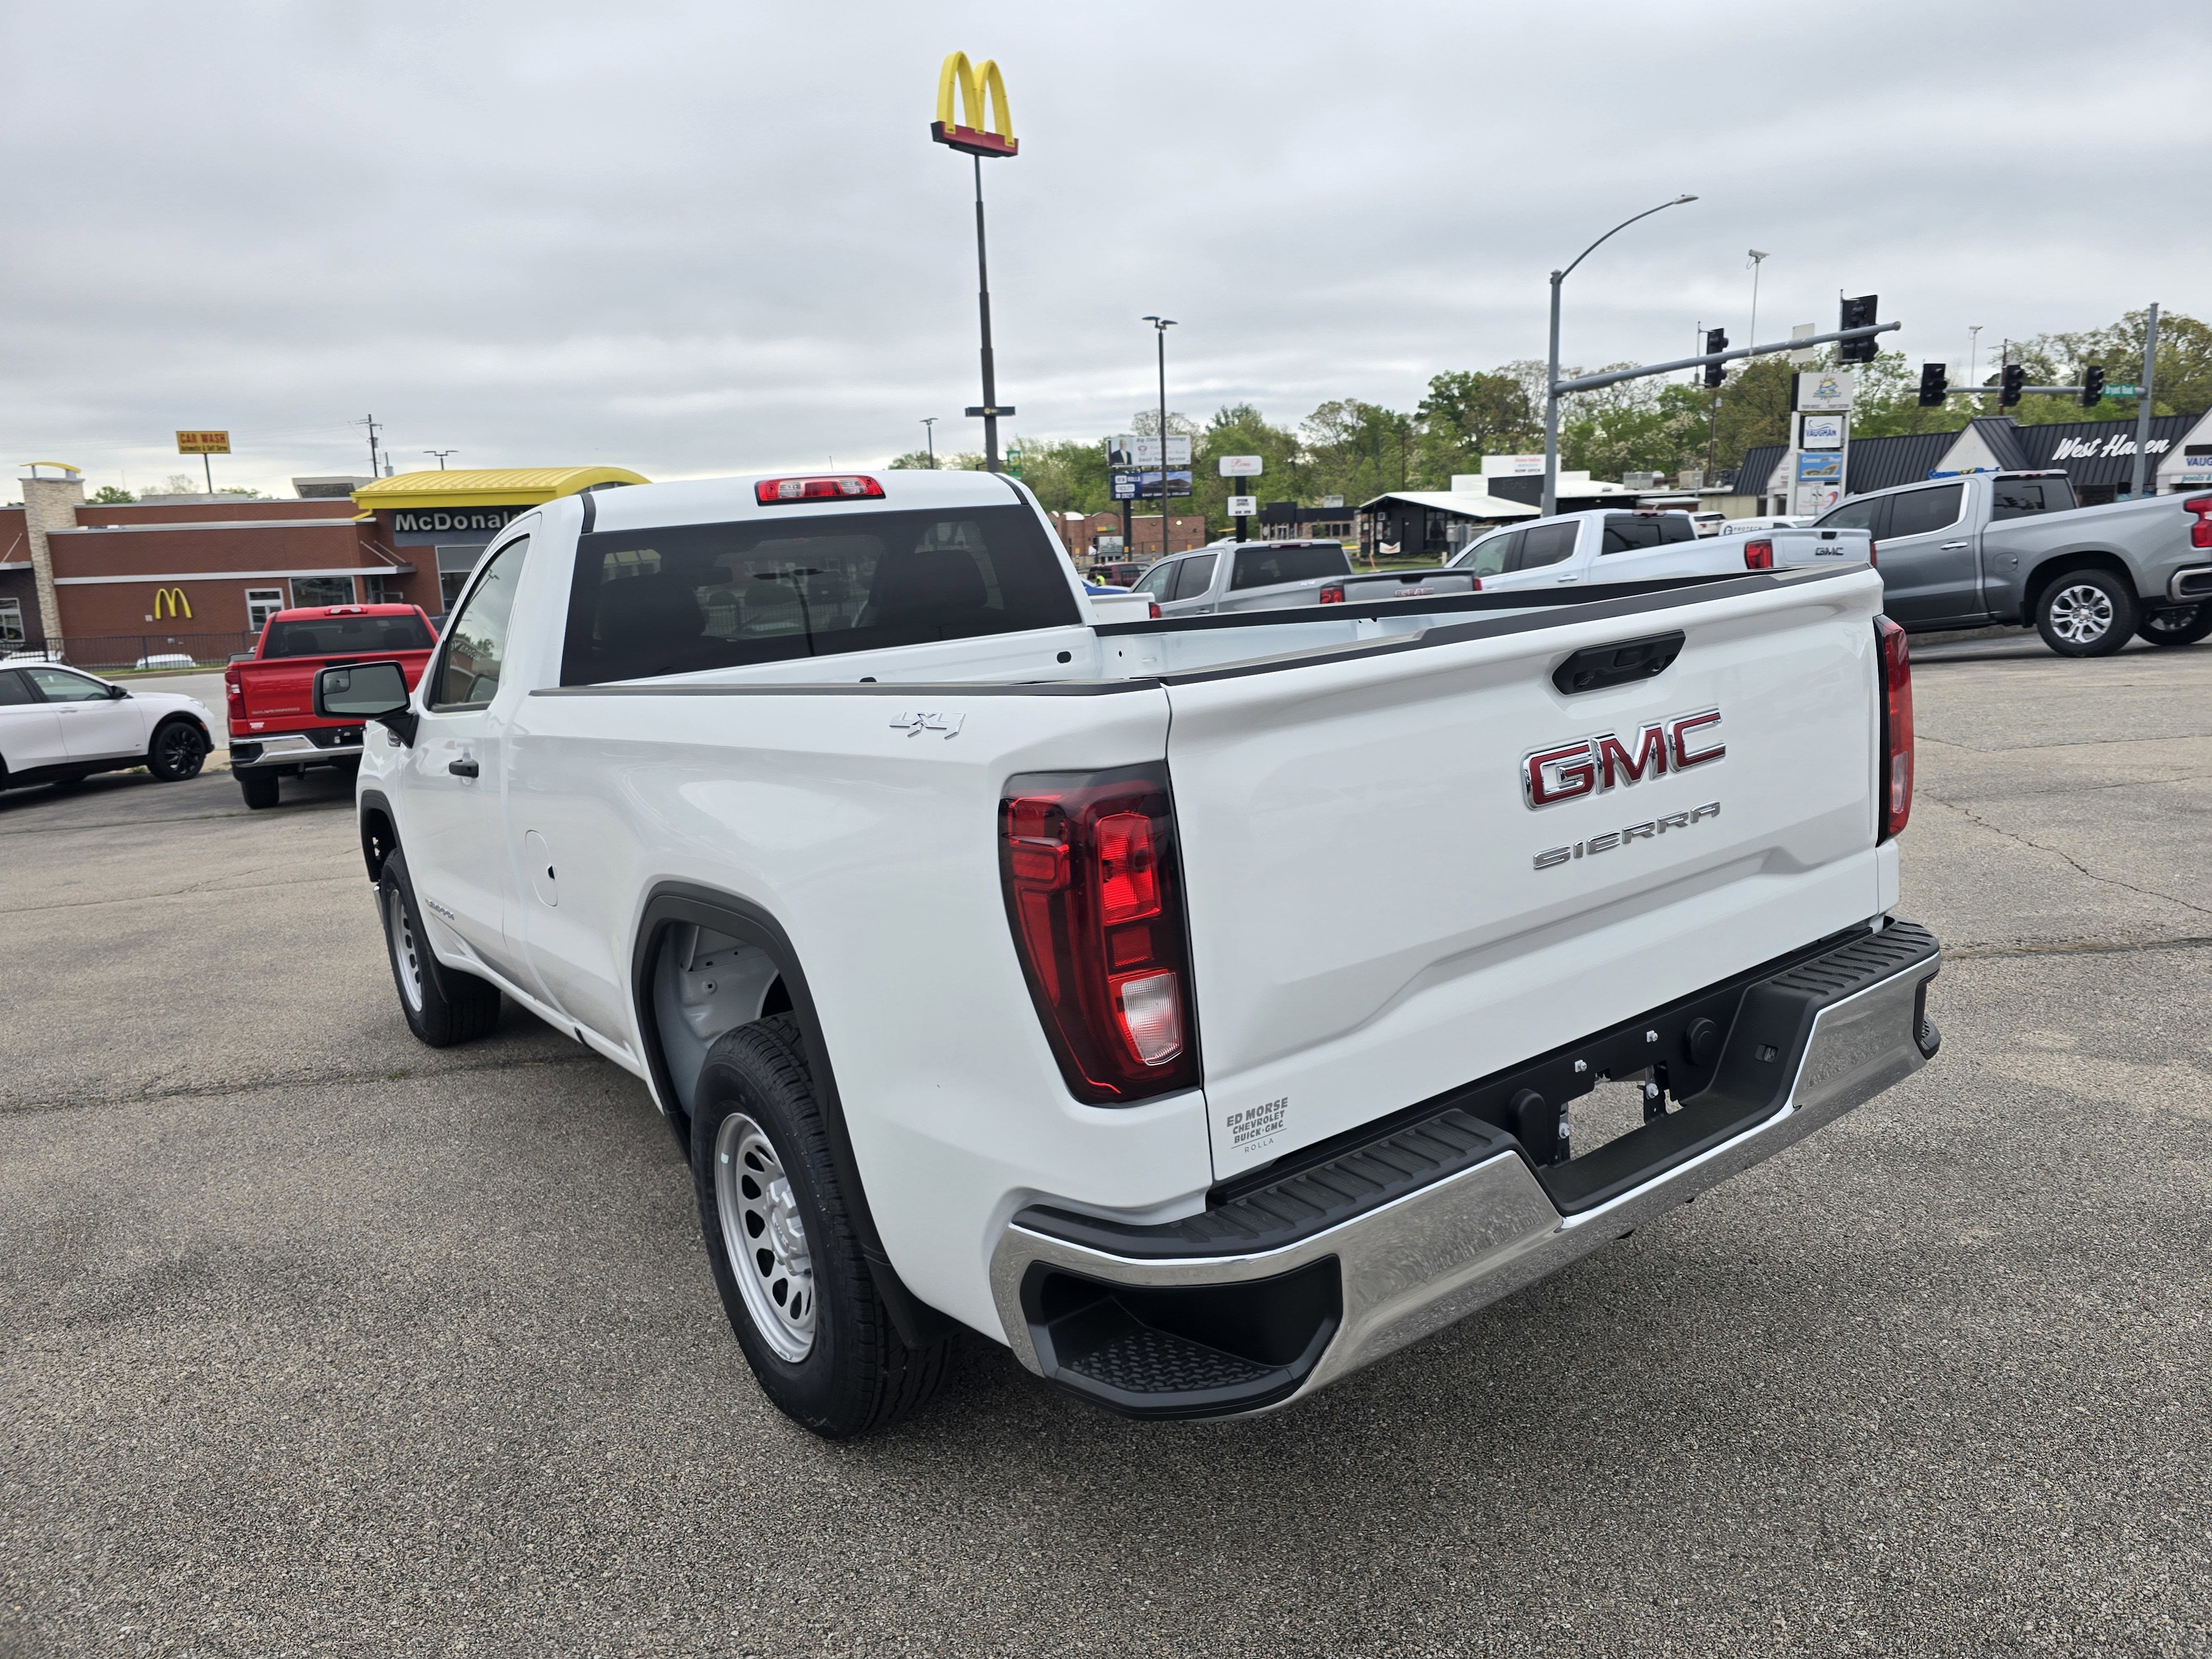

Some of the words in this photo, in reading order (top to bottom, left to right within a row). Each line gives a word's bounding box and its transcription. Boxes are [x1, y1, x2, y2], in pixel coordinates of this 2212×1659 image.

[180, 433, 197, 444] CAR
[201, 433, 226, 444] WASH
[2052, 437, 2103, 461] West
[2100, 434, 2170, 457] Haen
[1815, 547, 1844, 555] GMC
[1395, 587, 1434, 597] GMC
[1521, 706, 1726, 811] GMC
[1533, 800, 1721, 870] SIERRA
[1227, 1113, 1243, 1127] ED
[1245, 1097, 1288, 1121] MORSE
[1233, 1109, 1285, 1134] CHEVROLET
[1244, 1138, 1274, 1153] ROLLA
